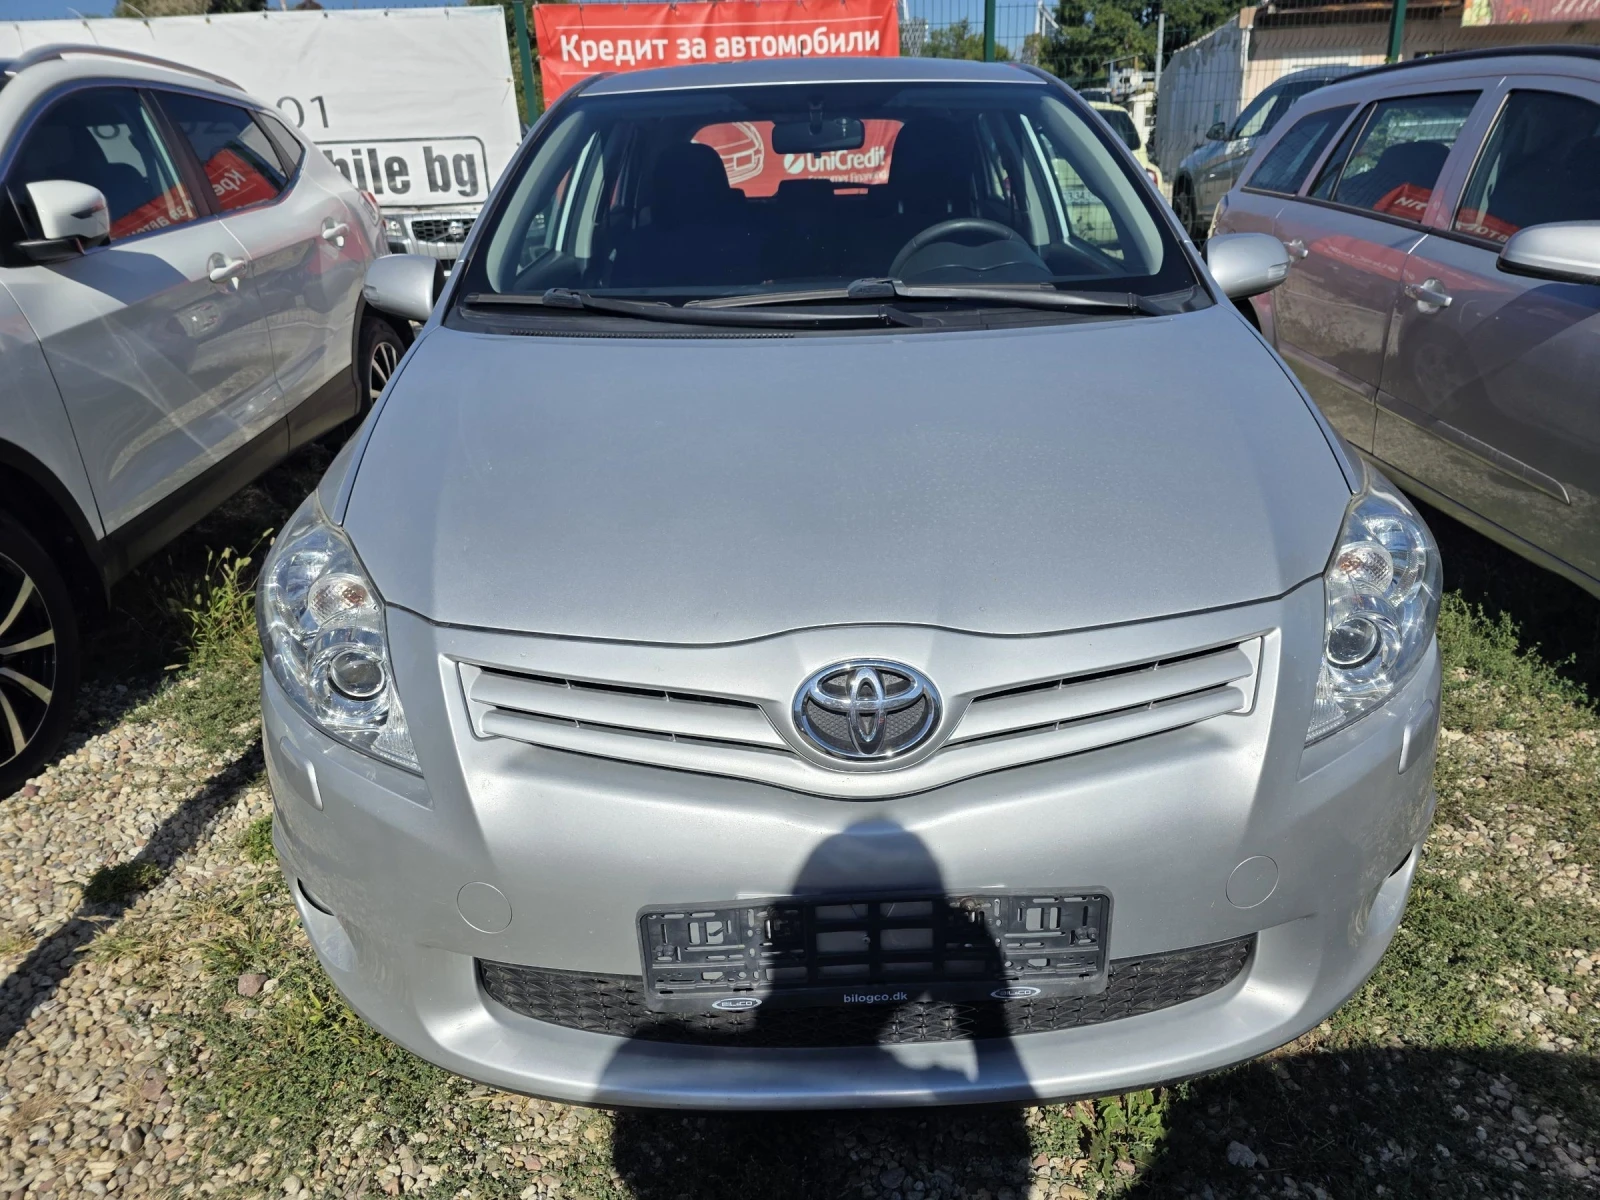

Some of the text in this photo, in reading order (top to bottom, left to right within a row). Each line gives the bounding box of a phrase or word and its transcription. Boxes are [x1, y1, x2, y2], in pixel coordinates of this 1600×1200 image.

[560, 27, 880, 67] Кредит за автомобили
[422, 146, 479, 197] bg
[806, 146, 886, 172] UniCredit
[843, 991, 908, 1004] bilogco.dk
